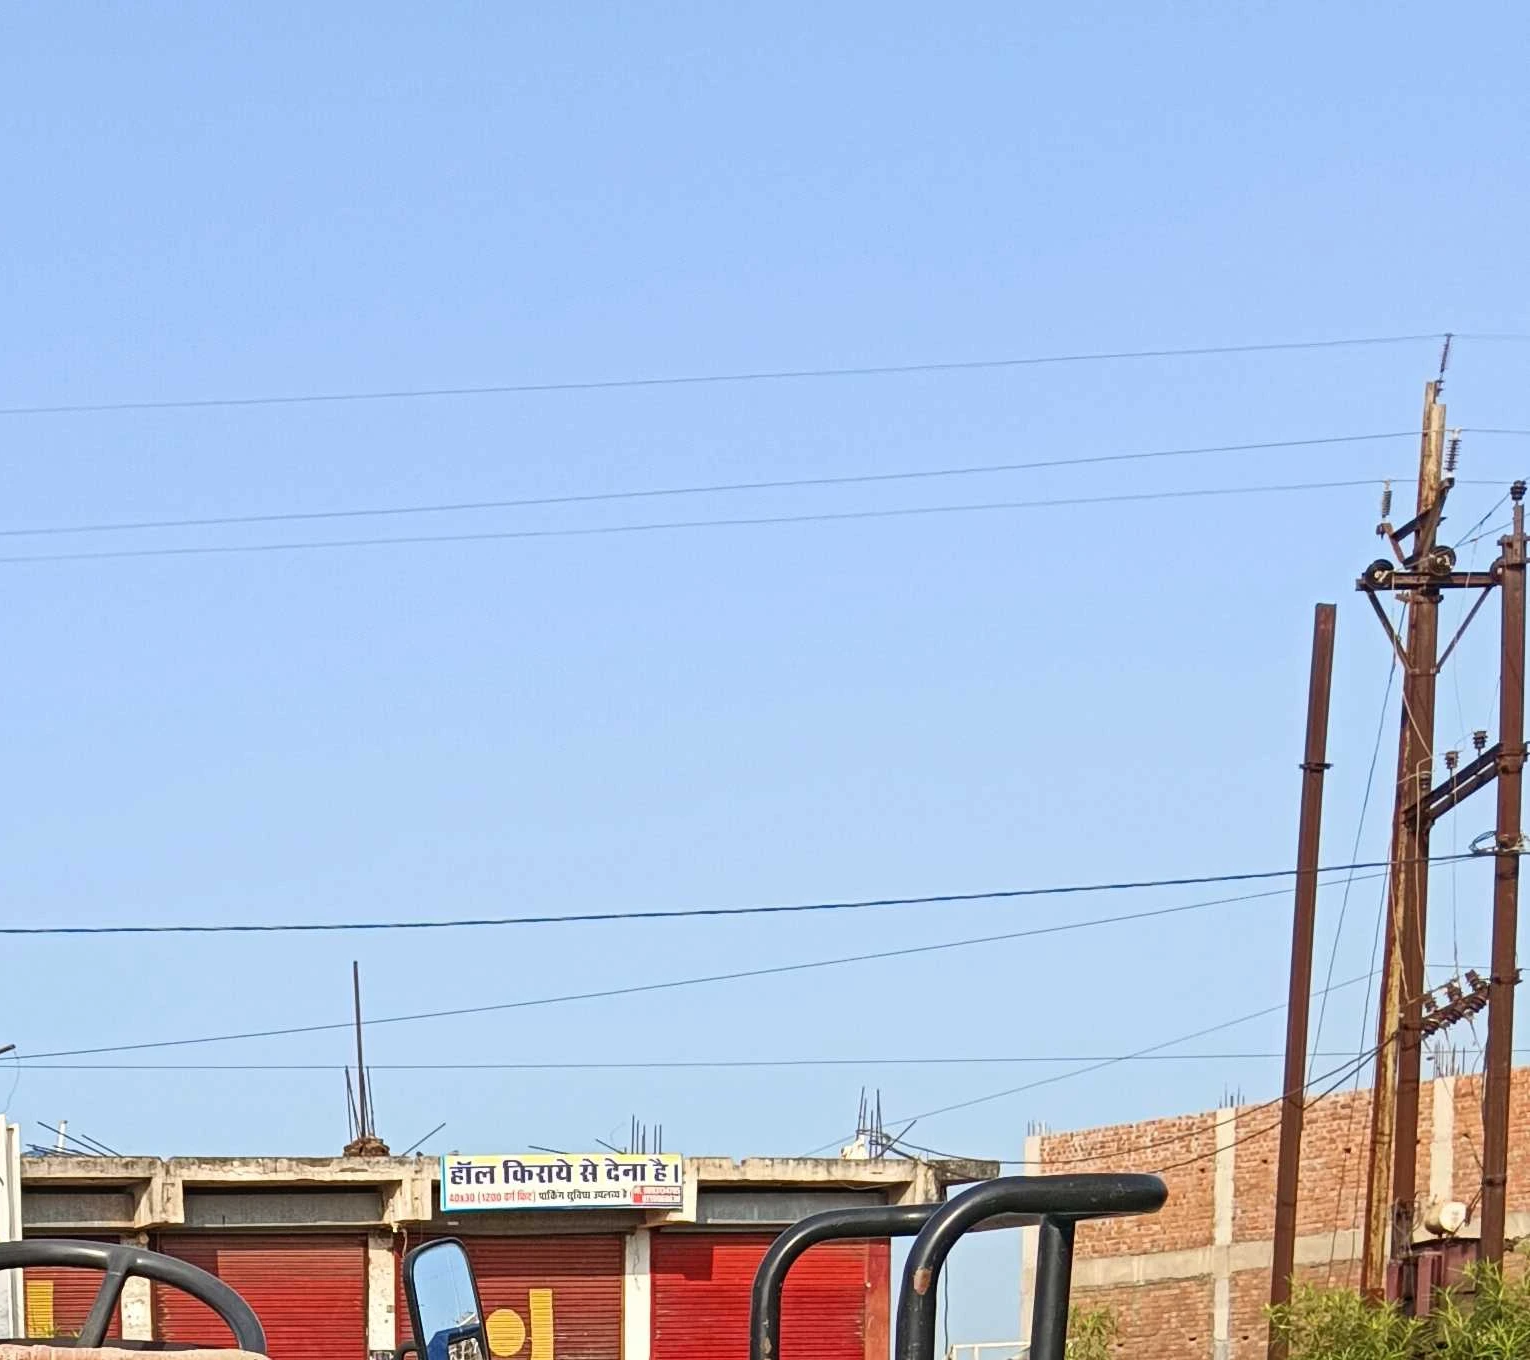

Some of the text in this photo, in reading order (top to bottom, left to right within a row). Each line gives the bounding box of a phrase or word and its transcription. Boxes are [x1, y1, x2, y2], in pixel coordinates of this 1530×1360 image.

[450, 1161, 496, 1185] हॉल
[503, 1159, 573, 1184] किराये
[580, 1159, 598, 1183] से
[605, 1158, 646, 1182] देना
